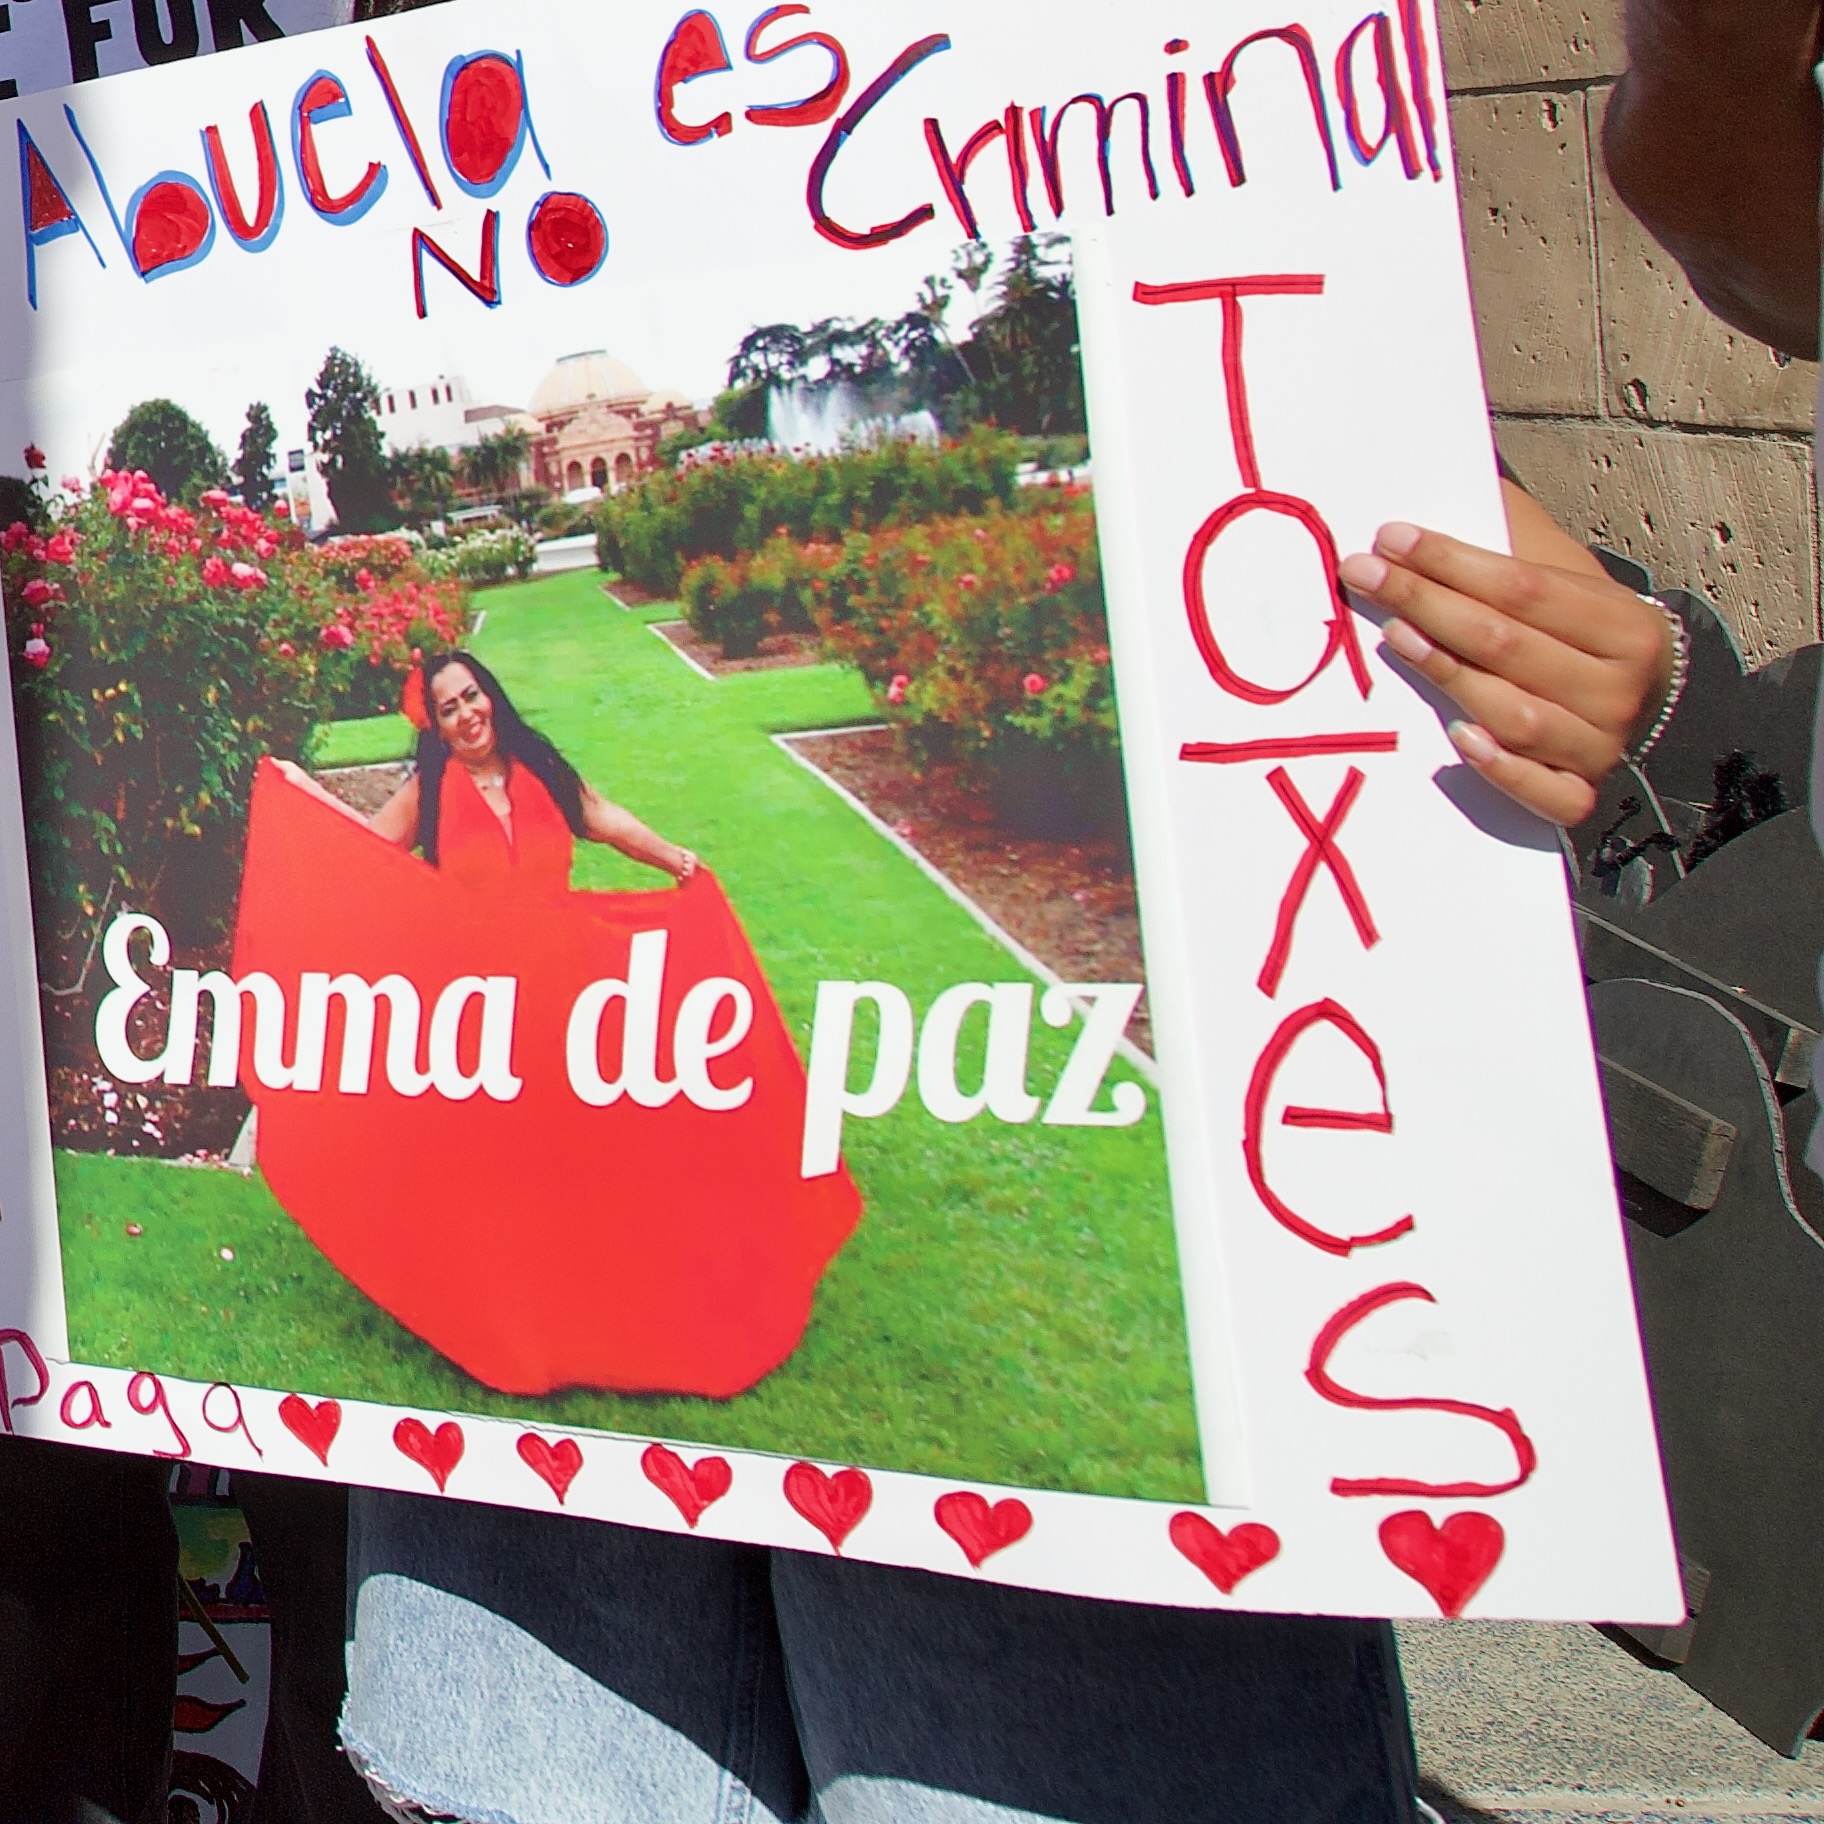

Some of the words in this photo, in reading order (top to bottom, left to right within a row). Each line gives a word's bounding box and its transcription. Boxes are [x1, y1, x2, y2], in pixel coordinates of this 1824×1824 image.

[16, 33, 551, 312] Abuela
[652, 2, 852, 146] es
[413, 191, 607, 319] NO
[94, 910, 522, 1102] Emma
[565, 928, 755, 1111] de
[802, 976, 1147, 1178] paz
